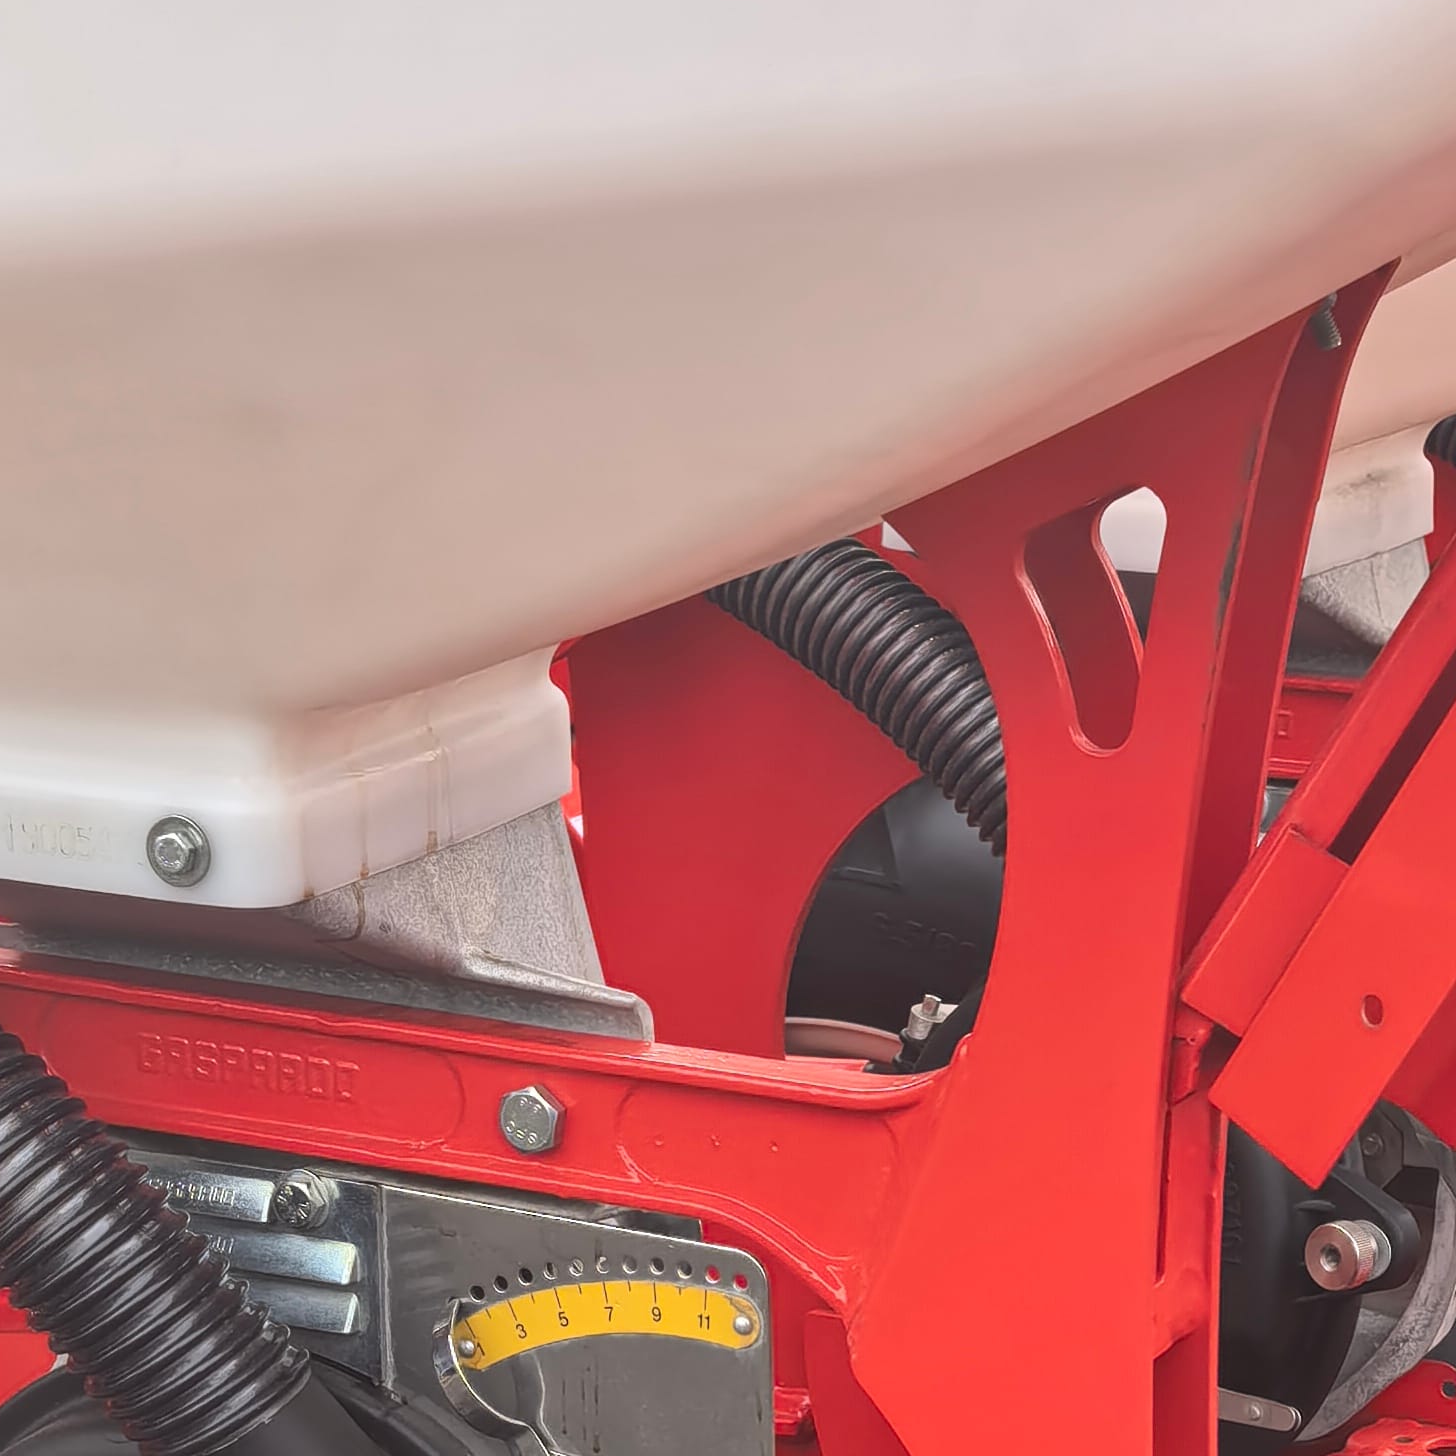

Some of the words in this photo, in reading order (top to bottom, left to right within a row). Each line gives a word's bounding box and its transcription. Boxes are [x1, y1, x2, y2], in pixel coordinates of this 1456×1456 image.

[137, 1033, 362, 1103] GASPARDO
[476, 1342, 485, 1356] 1
[515, 1323, 528, 1339] 3
[558, 1311, 569, 1327] 5
[603, 1306, 614, 1322] 7
[651, 1306, 662, 1322] 9
[697, 1314, 711, 1330] 11
